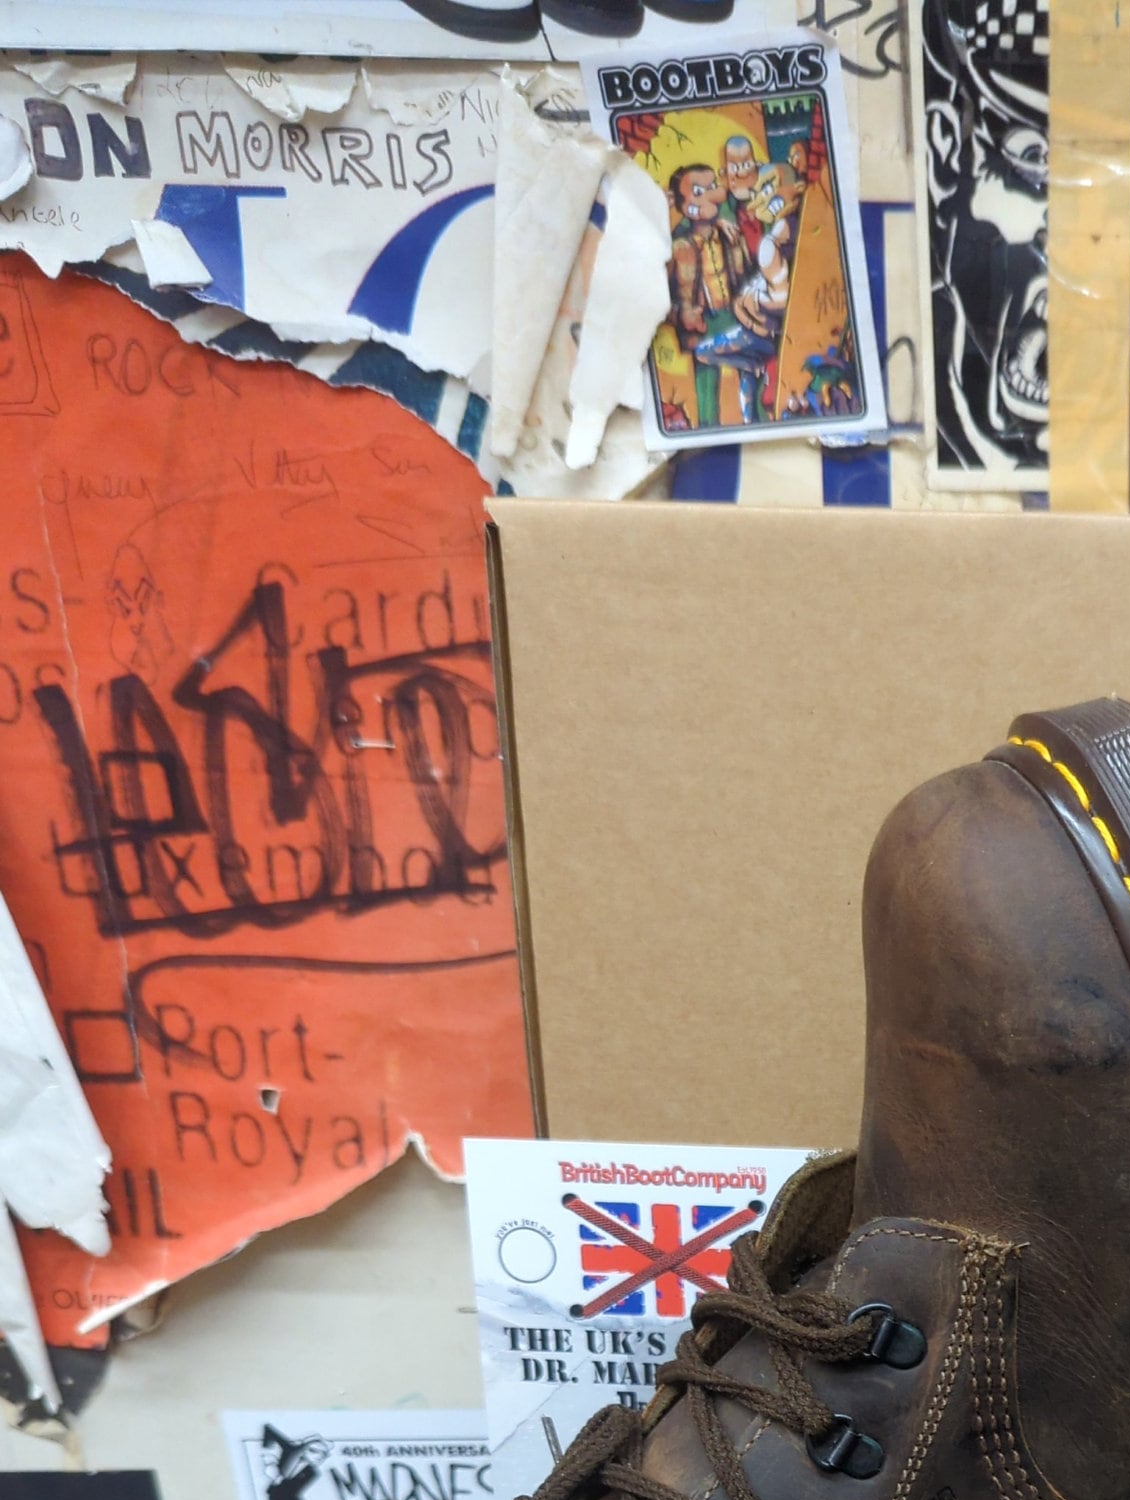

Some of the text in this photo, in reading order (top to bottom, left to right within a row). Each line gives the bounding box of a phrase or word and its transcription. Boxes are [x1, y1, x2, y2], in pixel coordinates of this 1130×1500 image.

[600, 45, 826, 106] BOOTBOYS
[174, 110, 454, 196] MORRIS
[170, 1091, 391, 1185] Royal
[504, 1327, 667, 1357] THE UK'S
[521, 1358, 580, 1384] DR.
